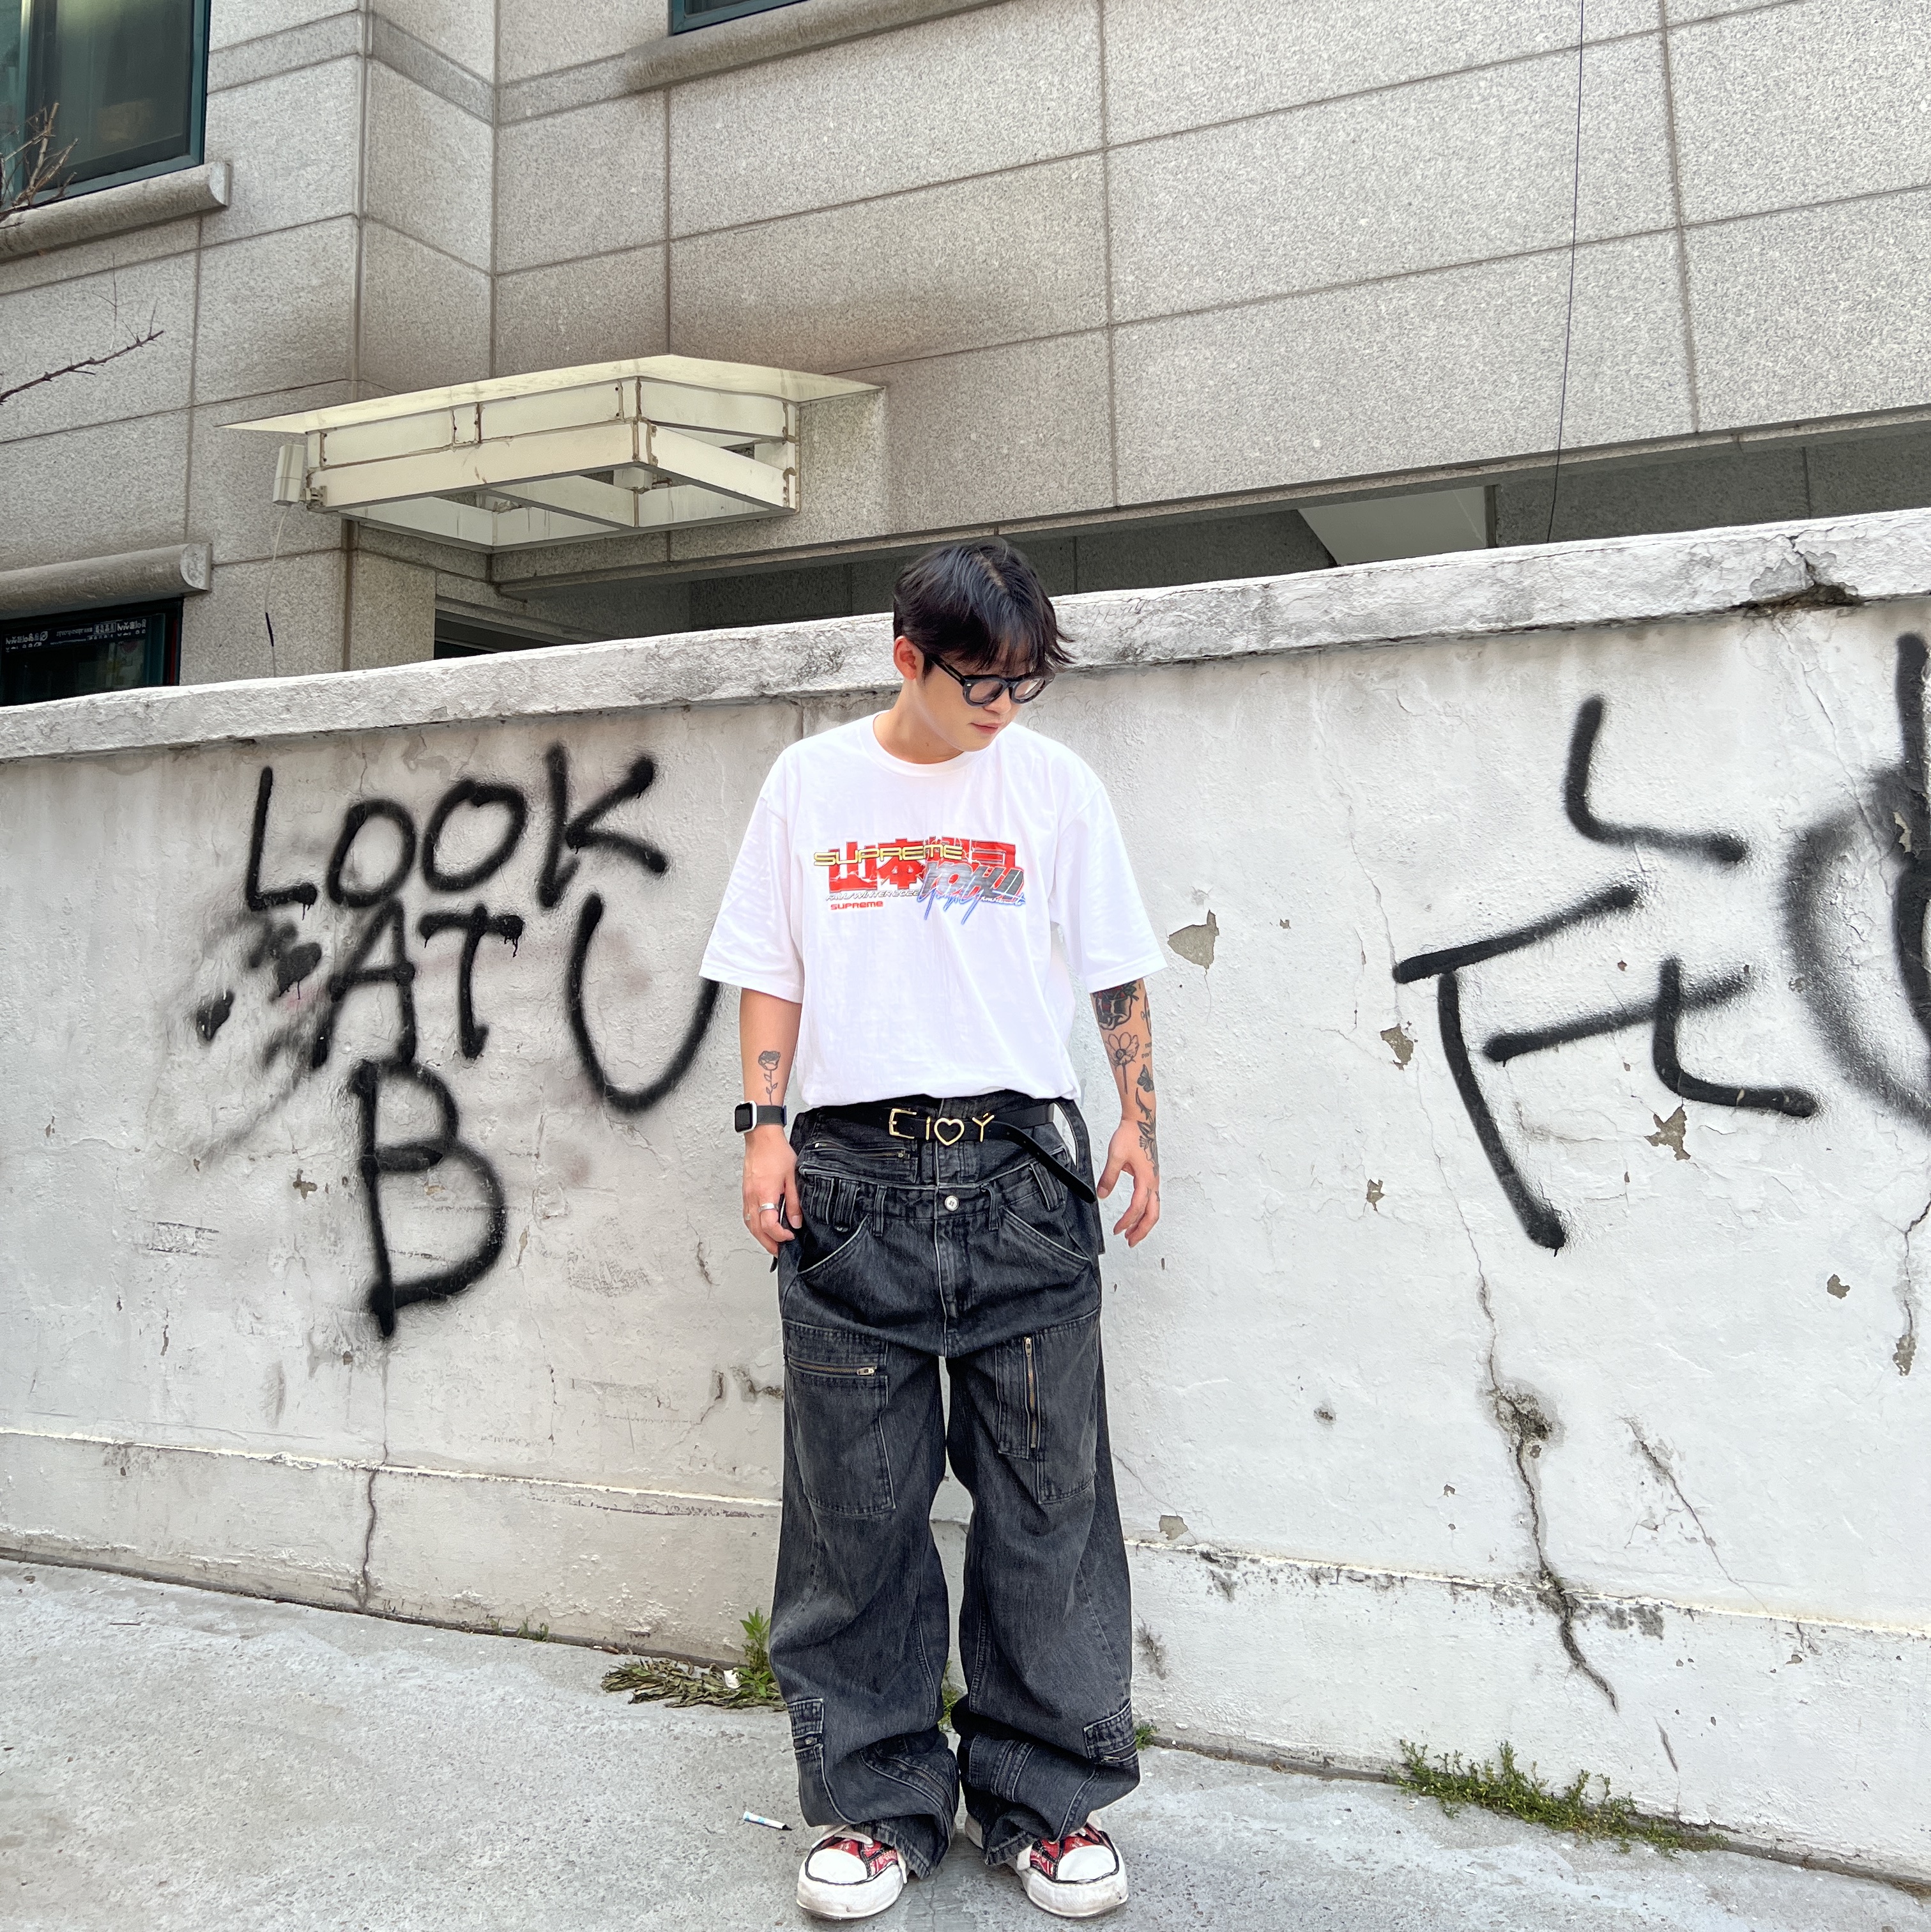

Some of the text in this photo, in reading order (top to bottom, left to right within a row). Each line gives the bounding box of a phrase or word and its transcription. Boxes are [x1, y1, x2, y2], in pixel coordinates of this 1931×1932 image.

[246, 741, 669, 910] LOOK
[813, 843, 963, 866] SUPREME
[311, 896, 524, 1070] AT
[353, 1054, 507, 1340] B
